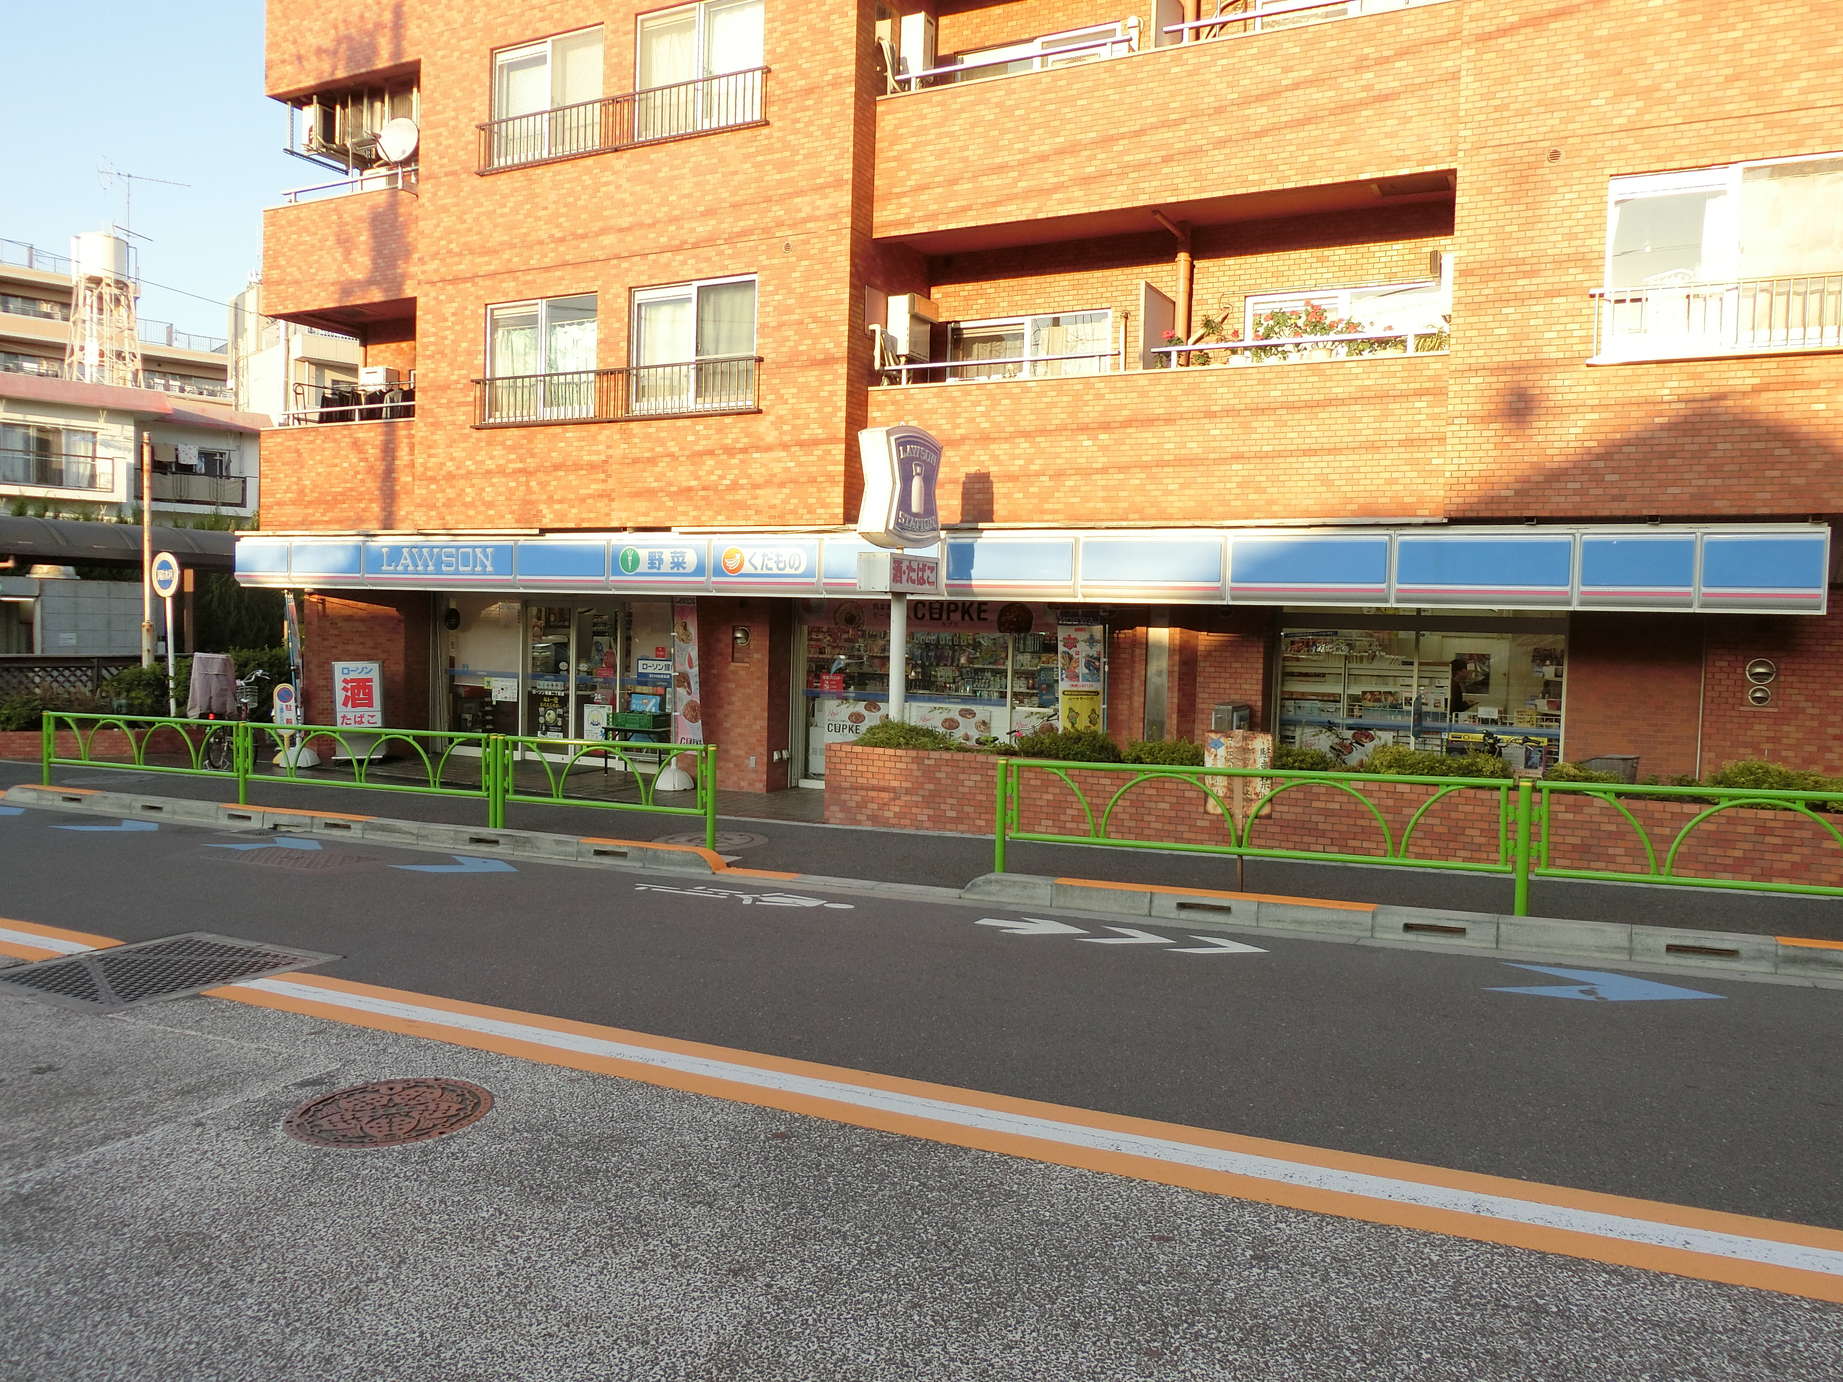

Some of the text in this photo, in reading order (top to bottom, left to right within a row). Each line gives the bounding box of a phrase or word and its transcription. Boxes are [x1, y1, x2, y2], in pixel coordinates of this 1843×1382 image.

[898, 511, 936, 533] STATION
[381, 547, 495, 571] LAWSON
[647, 551, 687, 571] 野菜
[748, 551, 802, 572] くだもの
[913, 601, 989, 621] CUPKE
[341, 666, 374, 675] ローソン
[341, 677, 374, 708] 酒
[340, 713, 377, 725] たばこ
[827, 722, 861, 735] CUPKE
